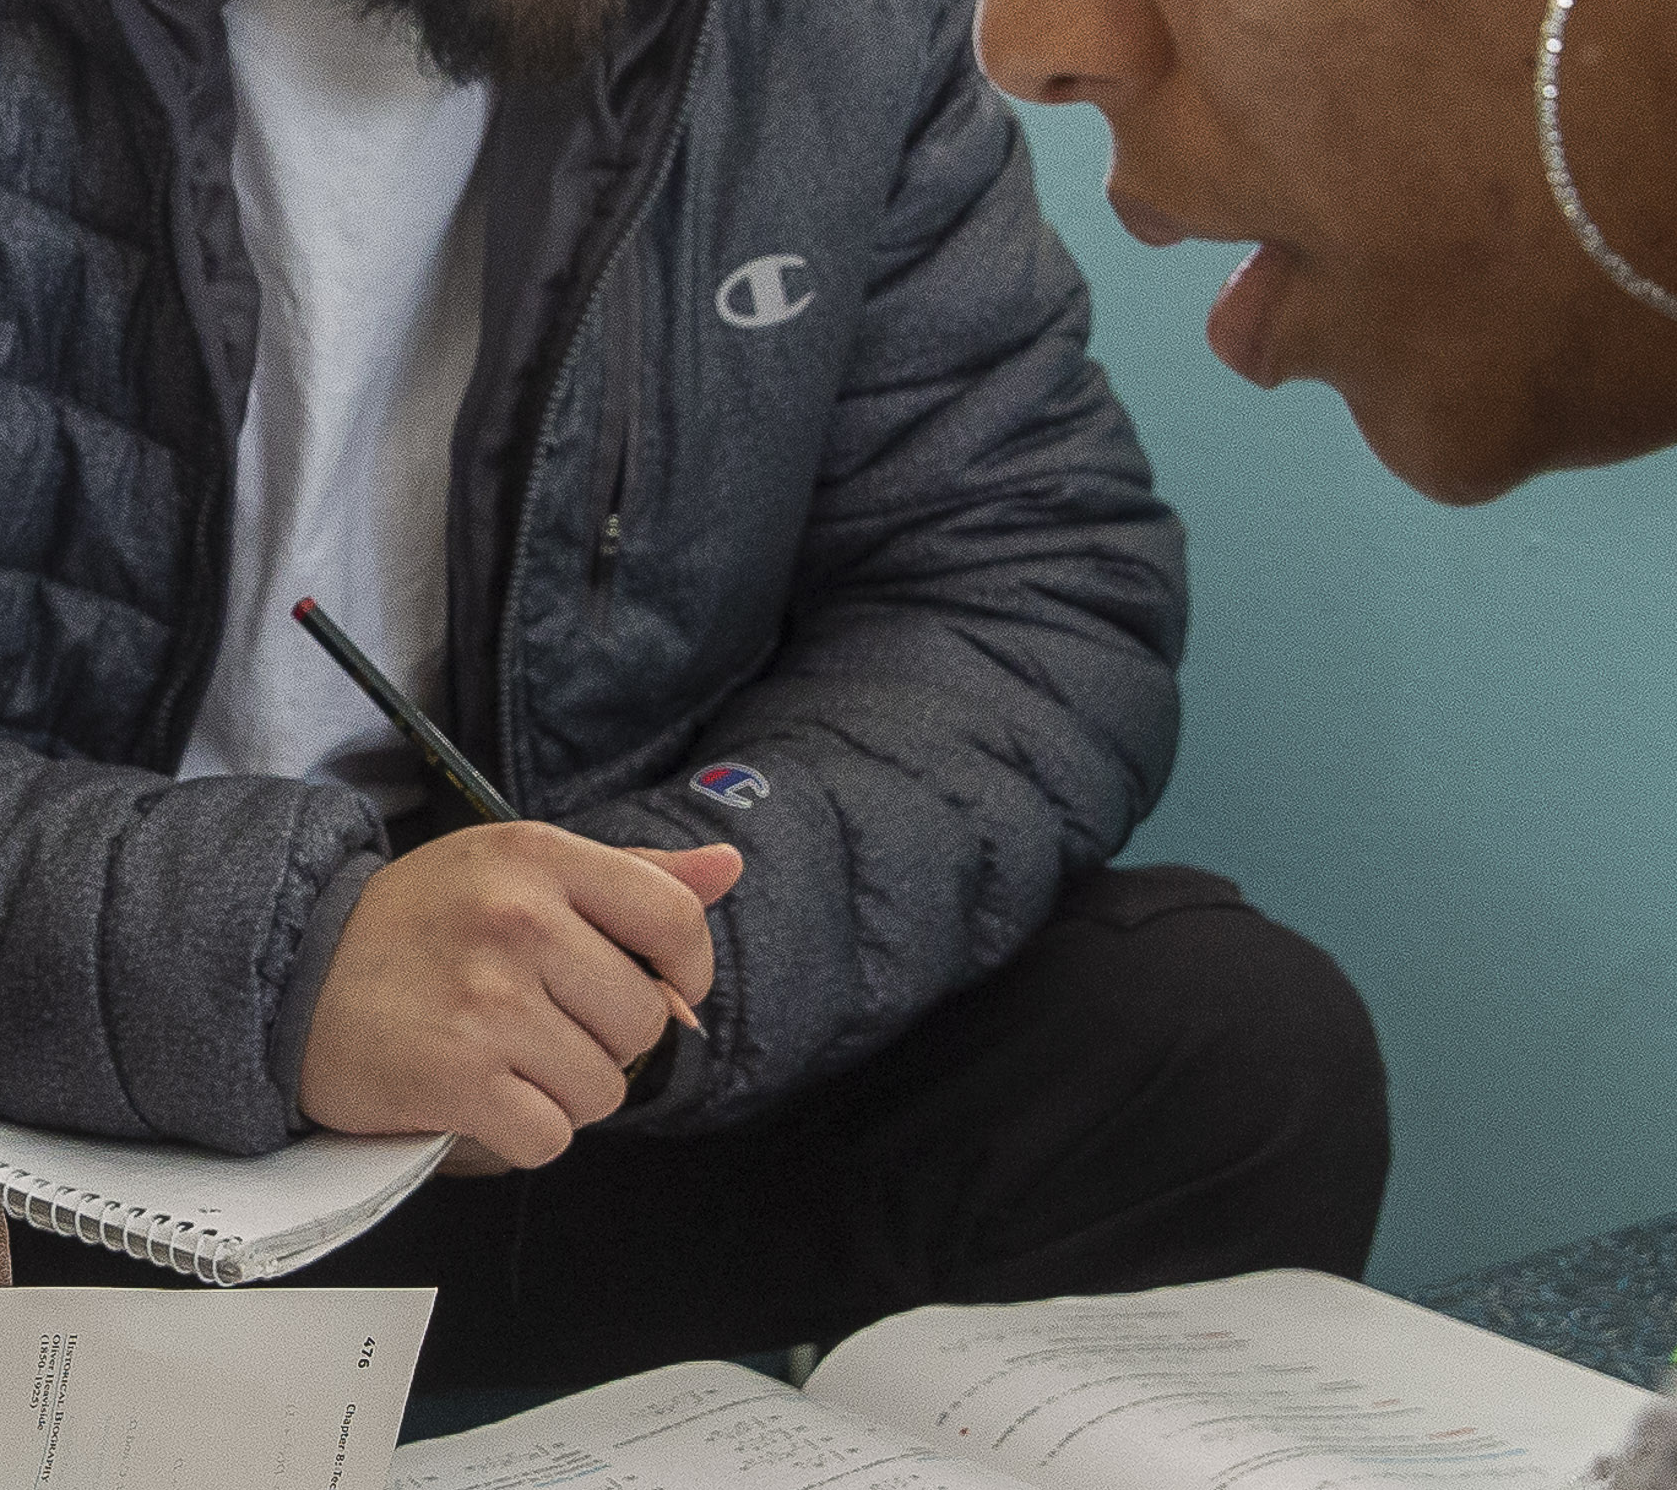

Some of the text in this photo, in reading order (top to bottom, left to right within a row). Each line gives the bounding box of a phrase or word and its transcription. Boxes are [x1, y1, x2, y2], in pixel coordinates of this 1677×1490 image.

[357, 1336, 377, 1369] 476
[36, 1333, 62, 1432] Oliver Heaviside
[40, 1333, 79, 1484] HISTORICAL BIOGRAPHY
[337, 1403, 357, 1453] Chapter
[333, 1452, 346, 1469] 8:
